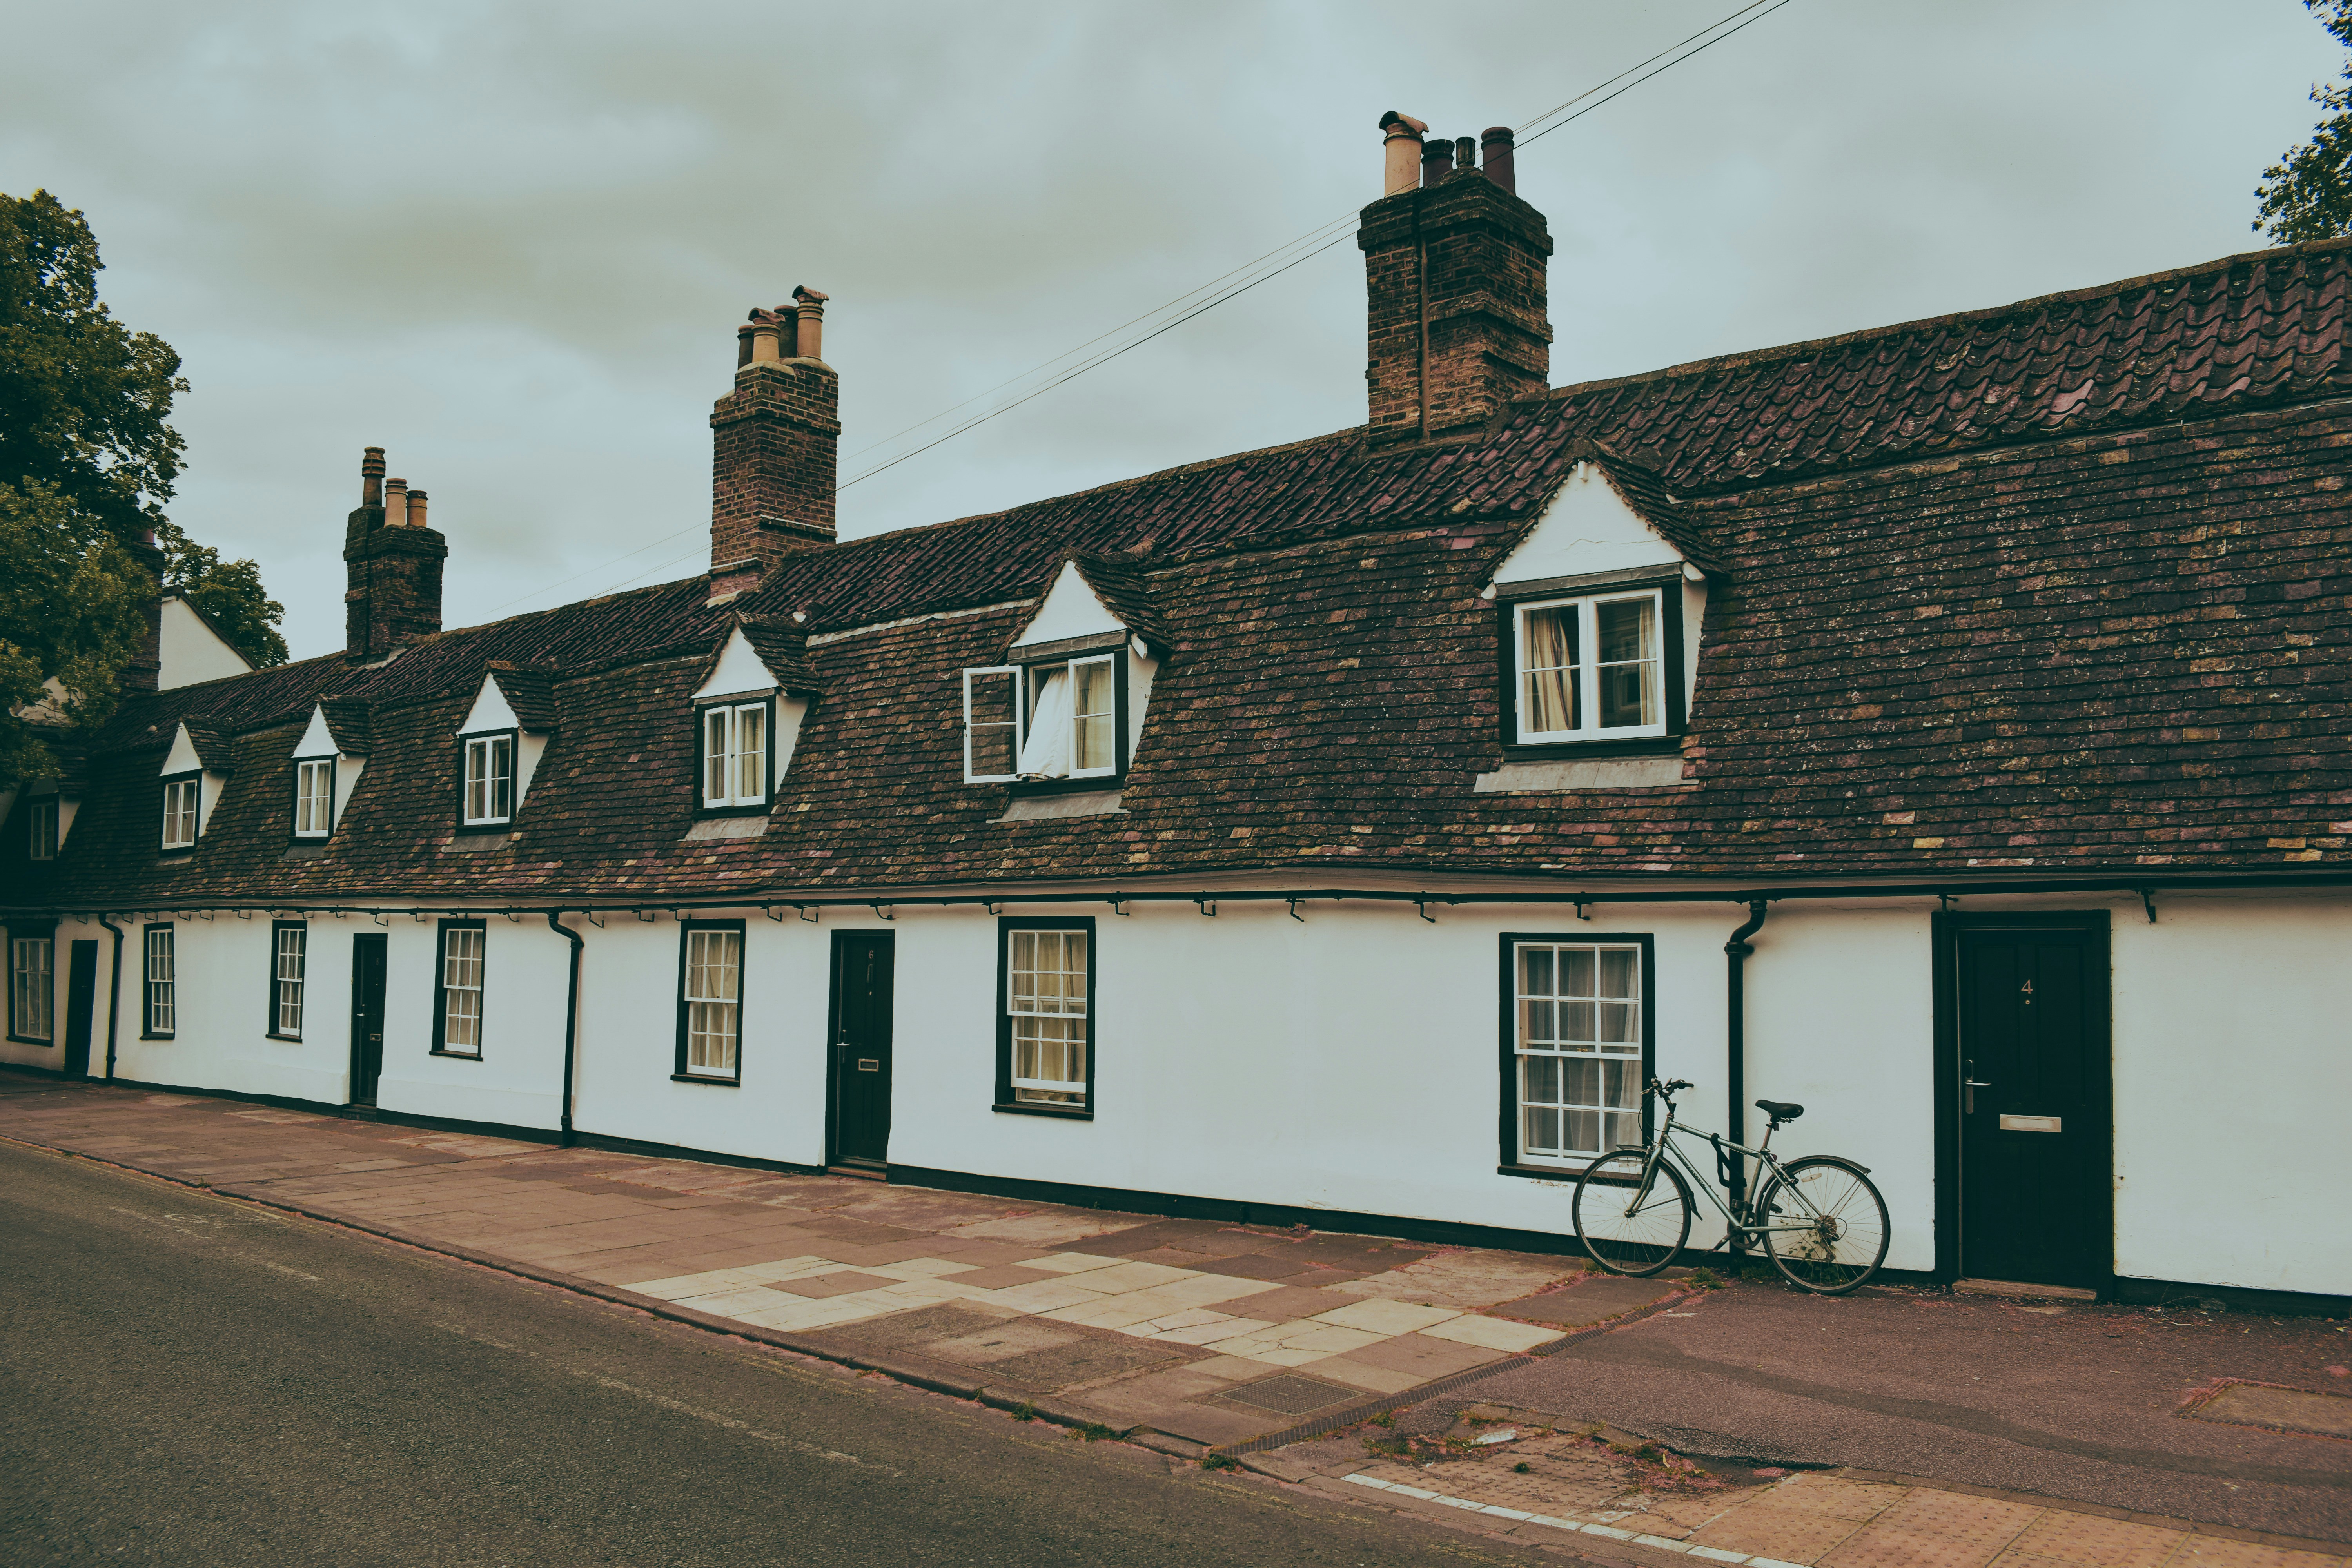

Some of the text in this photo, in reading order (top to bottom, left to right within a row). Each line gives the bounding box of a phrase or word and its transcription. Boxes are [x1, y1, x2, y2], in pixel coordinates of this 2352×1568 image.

[869, 950, 873, 959] 6
[2021, 979, 2033, 994] 4
[1676, 1154, 1707, 1189] PROFESSIONAL
